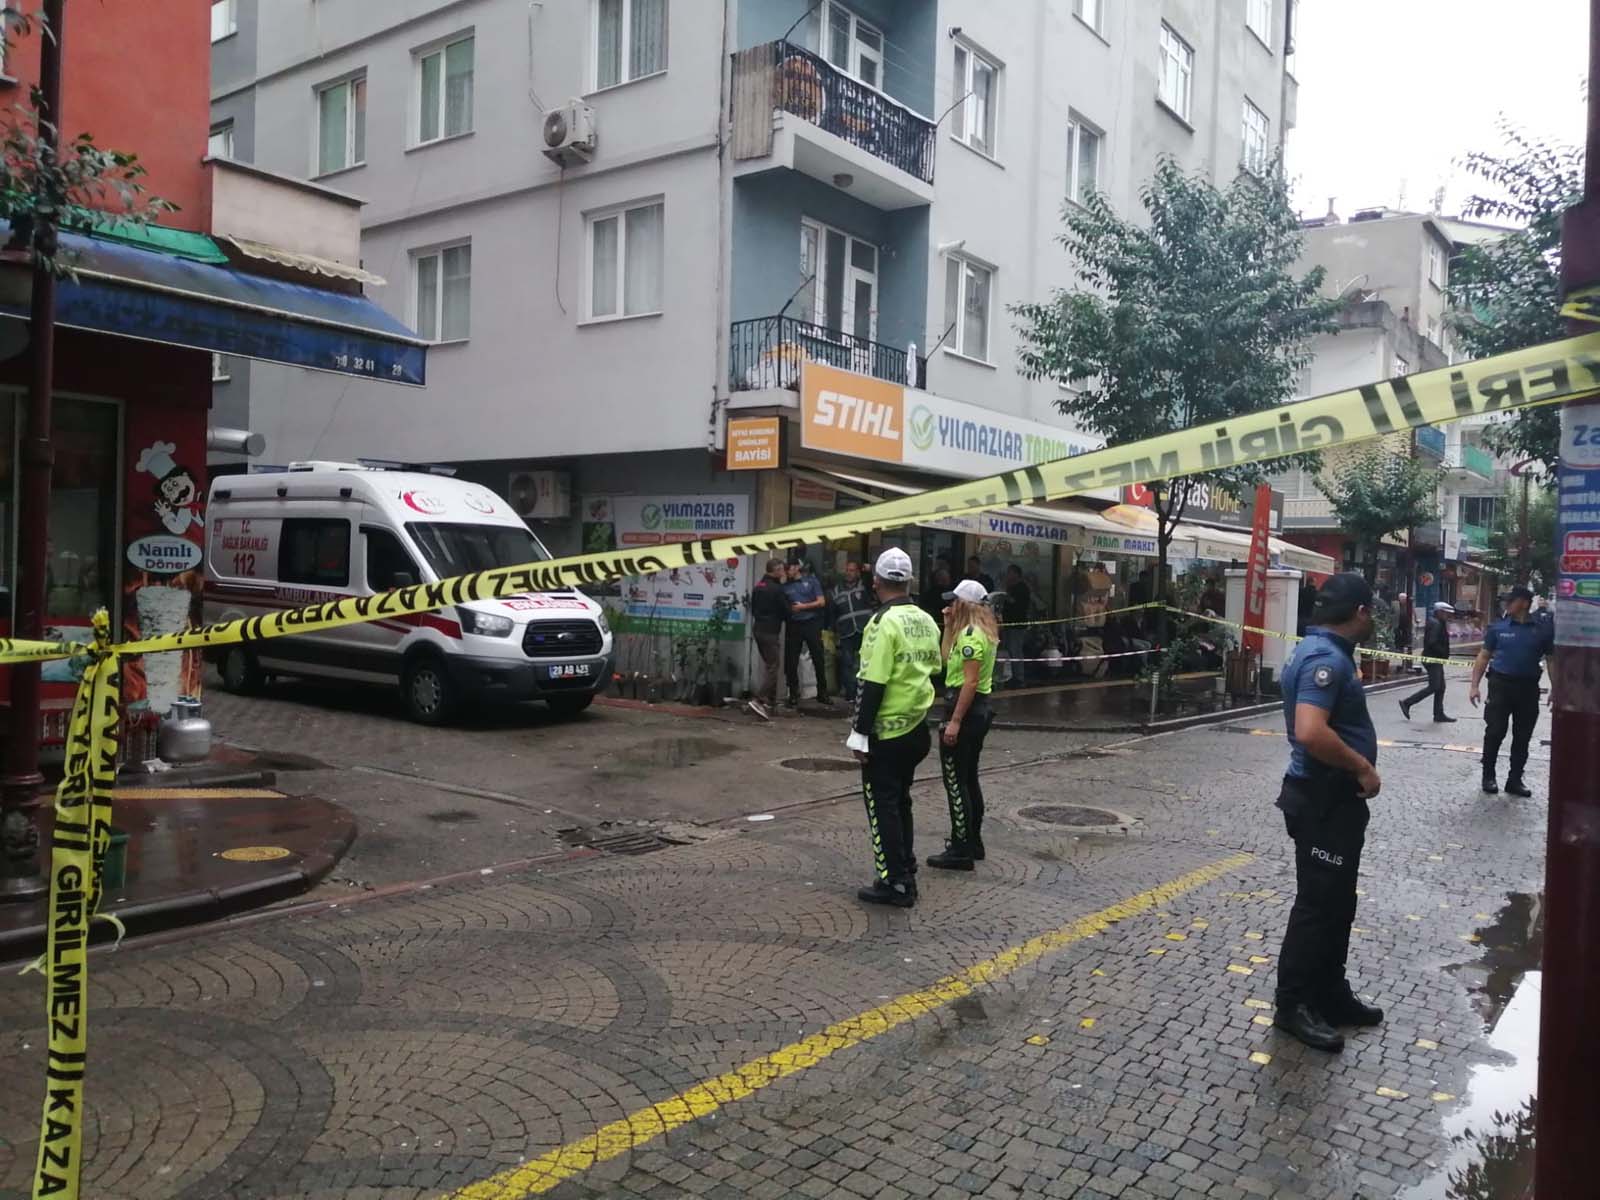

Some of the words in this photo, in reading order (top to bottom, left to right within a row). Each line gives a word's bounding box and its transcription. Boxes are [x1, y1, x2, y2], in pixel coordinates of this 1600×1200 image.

[813, 390, 900, 440] STIHL
[939, 415, 1023, 461] YILMAZLAR
[662, 502, 735, 517] YILMAZLAR
[695, 519, 735, 530] MARKET
[989, 518, 1068, 541] YILMAZLAR
[138, 543, 192, 557] Namlı
[1123, 537, 1155, 552] MARKET
[145, 558, 190, 569] Döner
[233, 552, 256, 577] 112
[38, 1088, 74, 1197] KAZA
